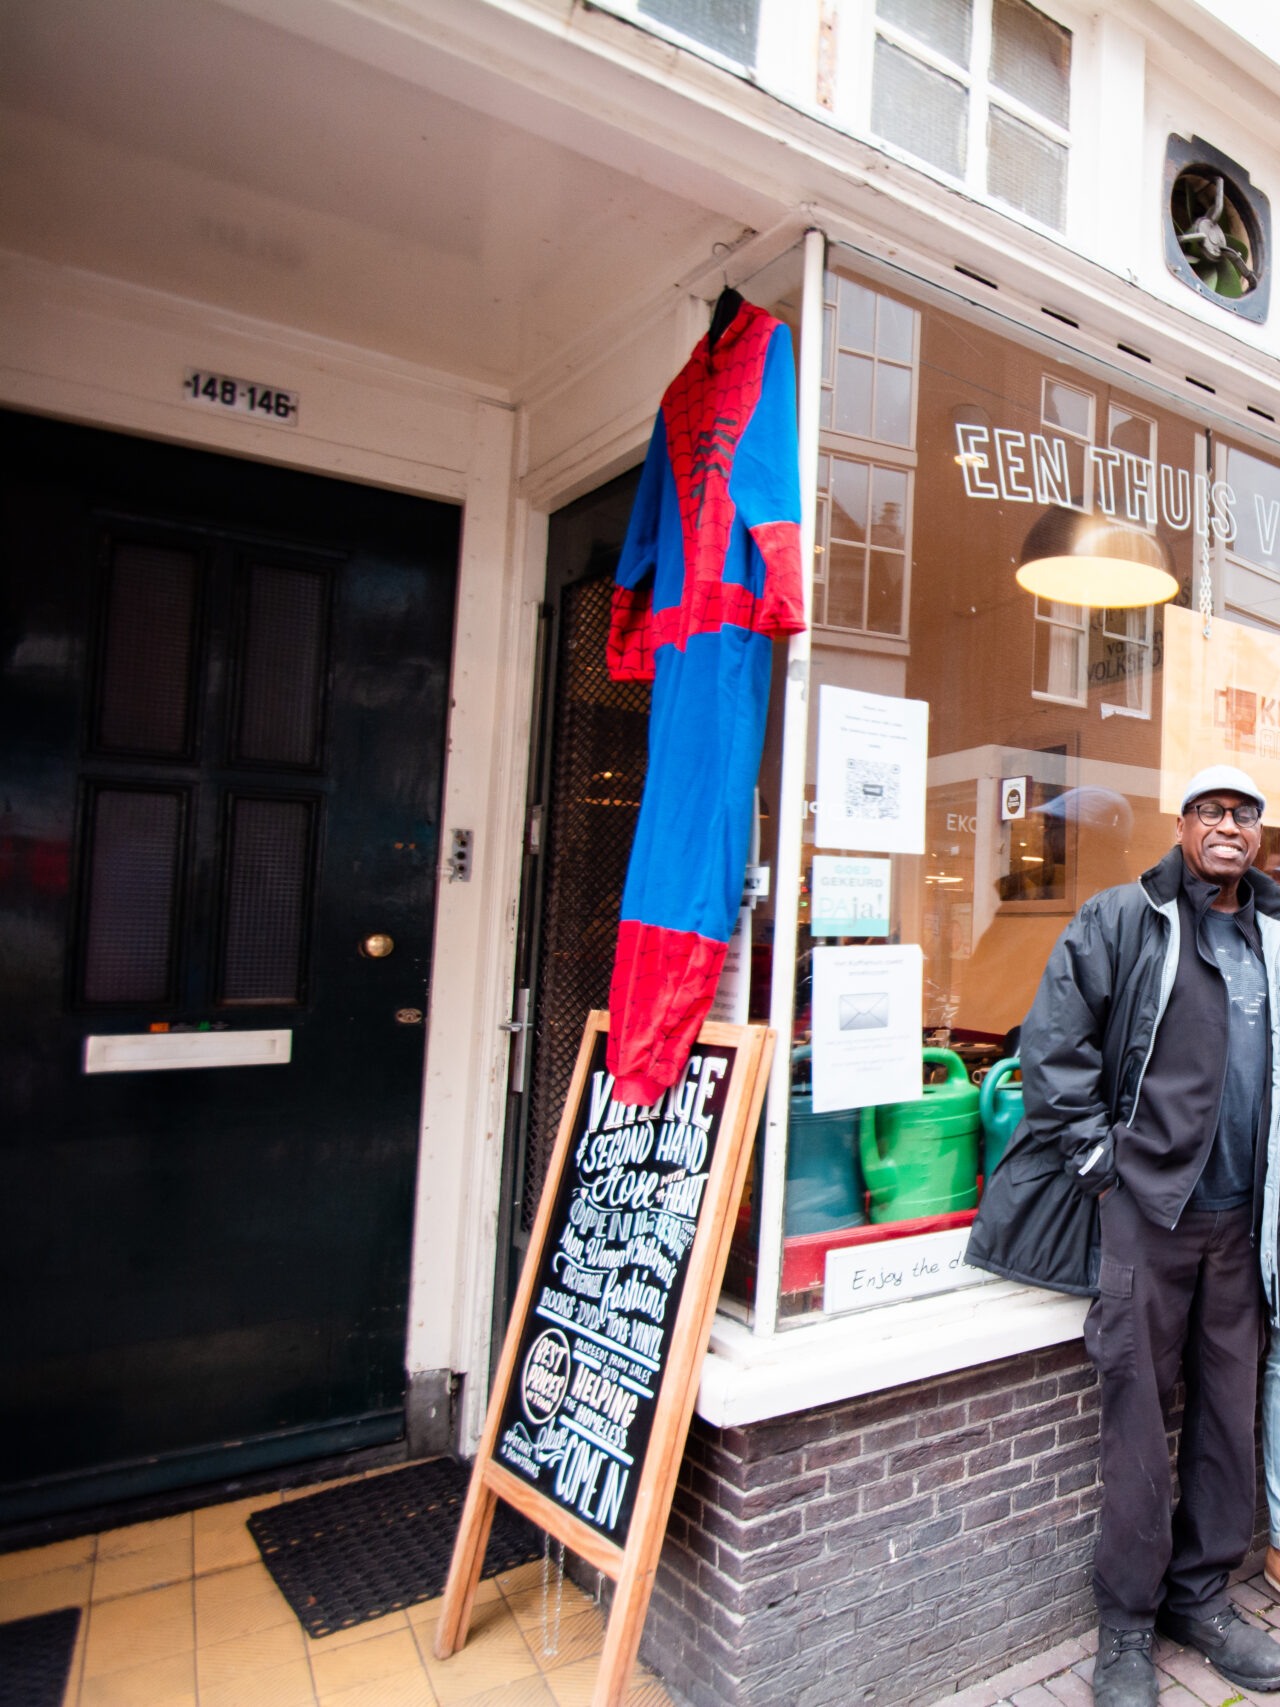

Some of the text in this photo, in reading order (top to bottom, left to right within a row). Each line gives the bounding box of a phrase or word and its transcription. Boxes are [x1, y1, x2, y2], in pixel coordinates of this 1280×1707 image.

[955, 423, 1072, 507] EEN
[1089, 446, 1237, 542] THUIS
[821, 877, 884, 888] GEKEURD
[834, 864, 871, 875] GOED
[583, 1121, 655, 1173] SECOND
[655, 1122, 708, 1174] HAND
[592, 1166, 659, 1209] Store
[661, 1168, 687, 1186] WITH
[662, 1173, 710, 1217] HEART
[570, 1198, 633, 1241] OPEN
[585, 1238, 626, 1269] Women
[852, 1268, 903, 1290] Enjoy
[912, 1257, 940, 1277] the
[562, 1264, 668, 1324] ORIGINAL fashions
[540, 1287, 577, 1319] BOOKS
[630, 1319, 665, 1361] VINYL
[534, 1337, 568, 1373] BEST
[574, 1338, 653, 1385] PROCEEDS FROM SALES
[526, 1363, 566, 1402] PRICES
[570, 1363, 638, 1428] HELPING
[504, 1429, 533, 1458] UPSTAIRS
[564, 1396, 629, 1450] THE HOMELESS
[505, 1446, 541, 1479] DOWNSTAIRS
[555, 1433, 630, 1530] COME IN
